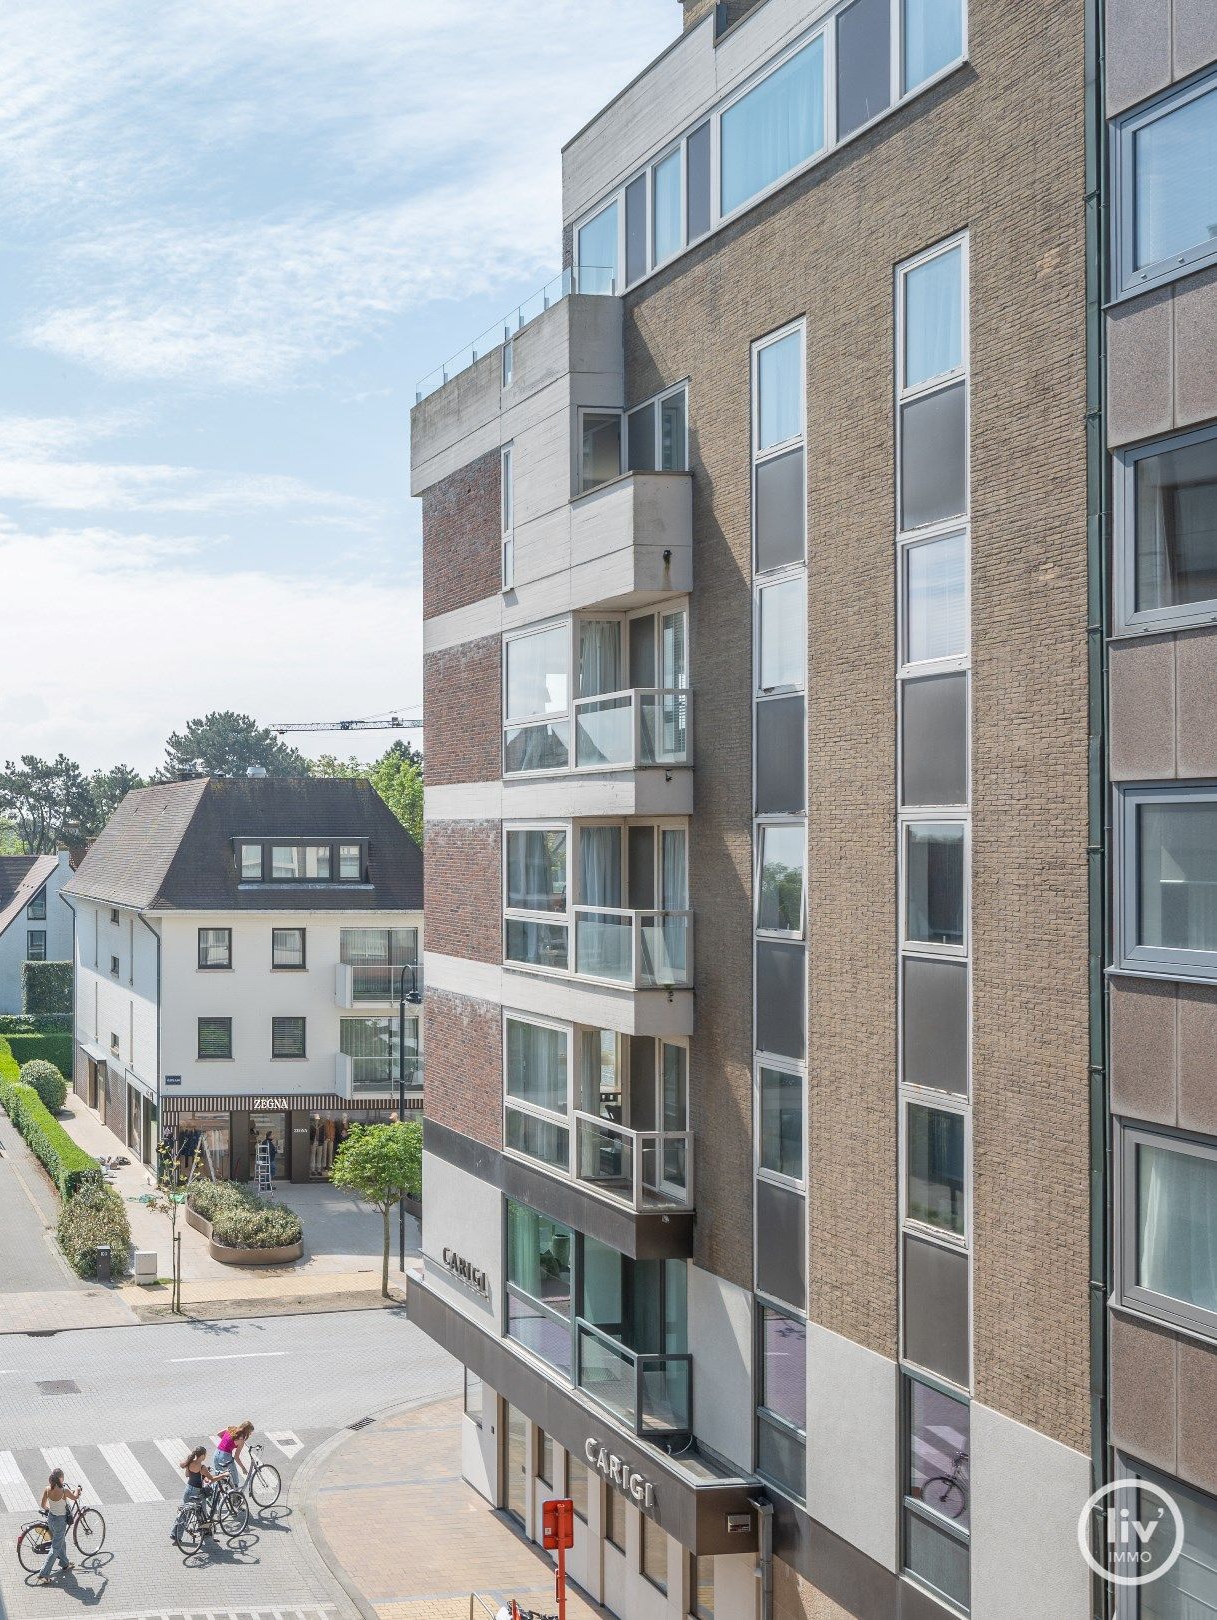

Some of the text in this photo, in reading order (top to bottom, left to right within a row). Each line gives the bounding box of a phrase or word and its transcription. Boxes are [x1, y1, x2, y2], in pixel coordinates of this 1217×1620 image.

[254, 1098, 288, 1109] ZEGNA
[443, 1247, 486, 1291] CARIGI
[585, 1437, 654, 1508] CARIGI
